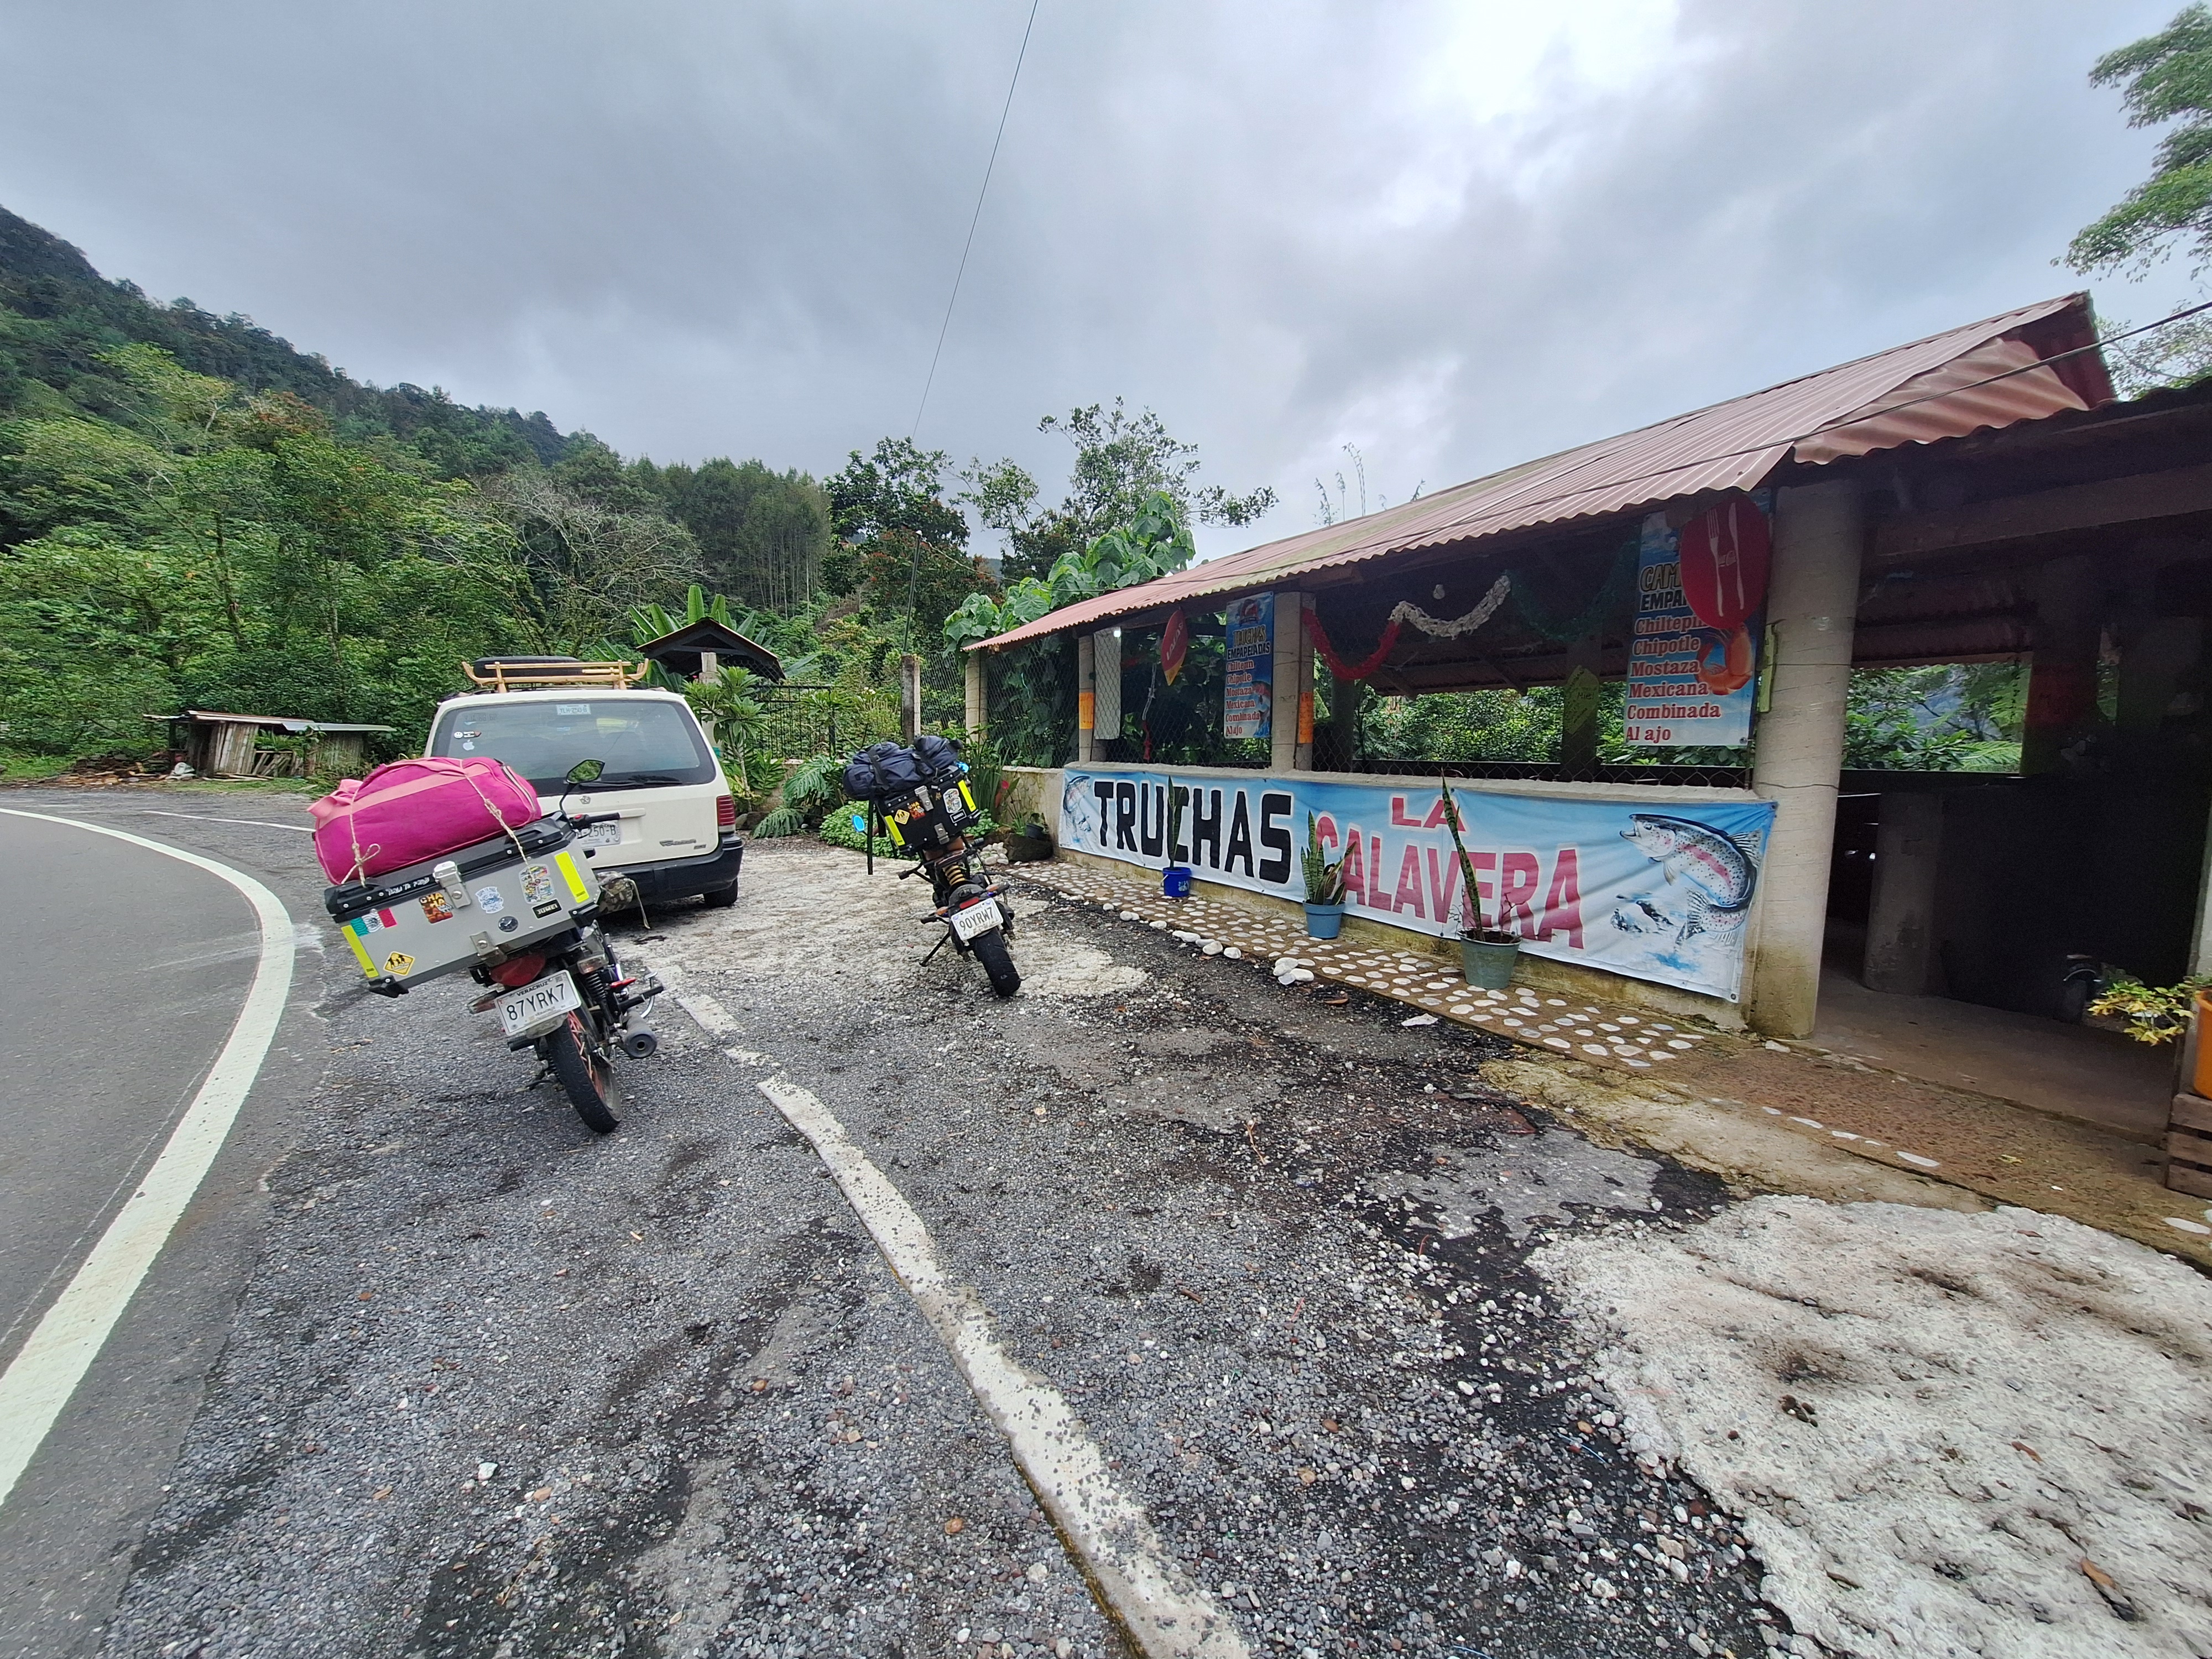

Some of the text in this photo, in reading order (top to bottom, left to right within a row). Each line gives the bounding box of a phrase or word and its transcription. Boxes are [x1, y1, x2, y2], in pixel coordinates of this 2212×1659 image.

[1234, 625, 1266, 647] TRUCHAS
[1227, 642, 1270, 659] EMPAPELADAS
[1633, 636, 1700, 656] Chipotle
[1630, 660, 1700, 677] Mostaza
[1226, 687, 1252, 697] Mostaza
[1629, 682, 1709, 698] Mexicana
[1225, 700, 1255, 709] Mexicana
[1627, 702, 1721, 719] Combinada
[1225, 711, 1260, 722] Combinada
[1626, 726, 1671, 744] Al ajo
[1391, 797, 1467, 832] LA
[1094, 781, 1292, 884] TRUCHAS
[959, 906, 994, 932] 90YRW7
[516, 980, 549, 997] VERACRUZ
[506, 983, 565, 1021] 87YRK7
